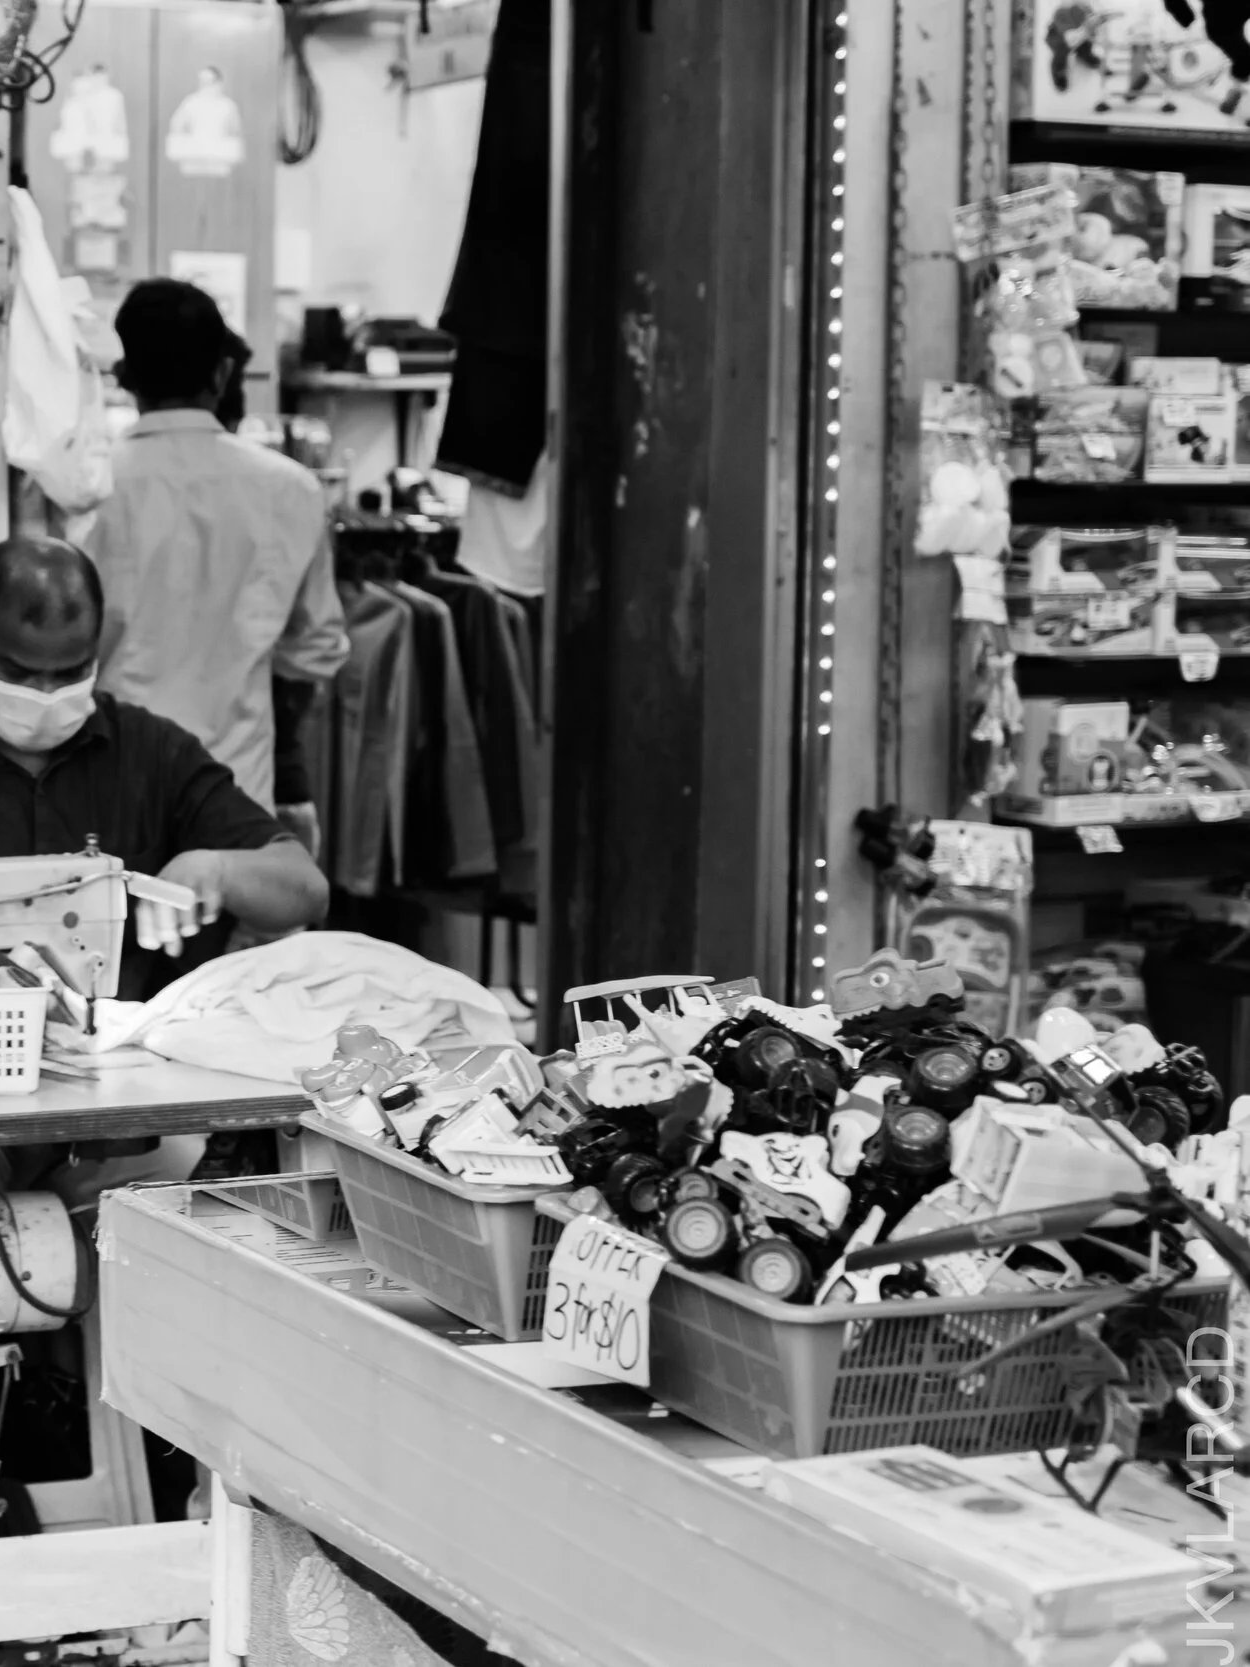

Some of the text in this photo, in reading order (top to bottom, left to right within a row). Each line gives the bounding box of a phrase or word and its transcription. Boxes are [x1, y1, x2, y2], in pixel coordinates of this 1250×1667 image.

[576, 1230, 648, 1281] OFFER
[545, 1281, 641, 1371] 3 for $10
